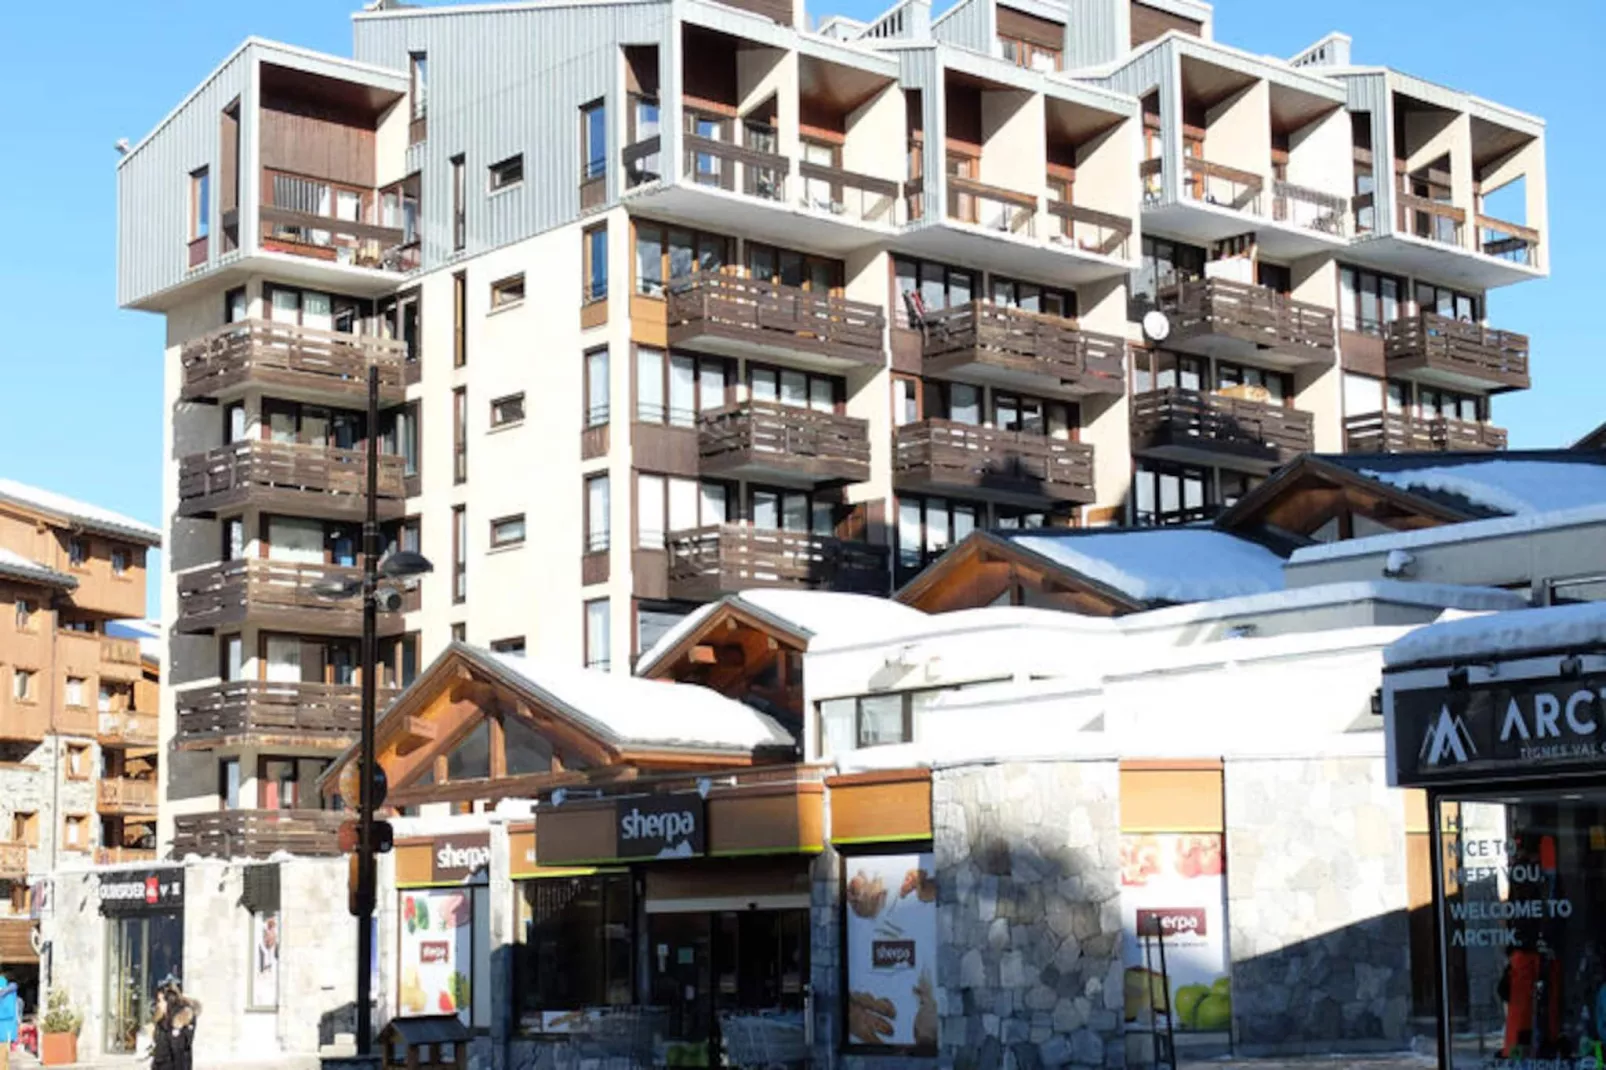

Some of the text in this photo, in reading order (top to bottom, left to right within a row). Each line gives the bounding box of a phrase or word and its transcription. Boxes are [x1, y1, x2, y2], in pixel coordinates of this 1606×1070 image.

[1500, 687, 1606, 741] ARC
[621, 808, 695, 842] sherpa
[437, 843, 490, 871] sherpa
[1449, 899, 1573, 920] WELCOME TO
